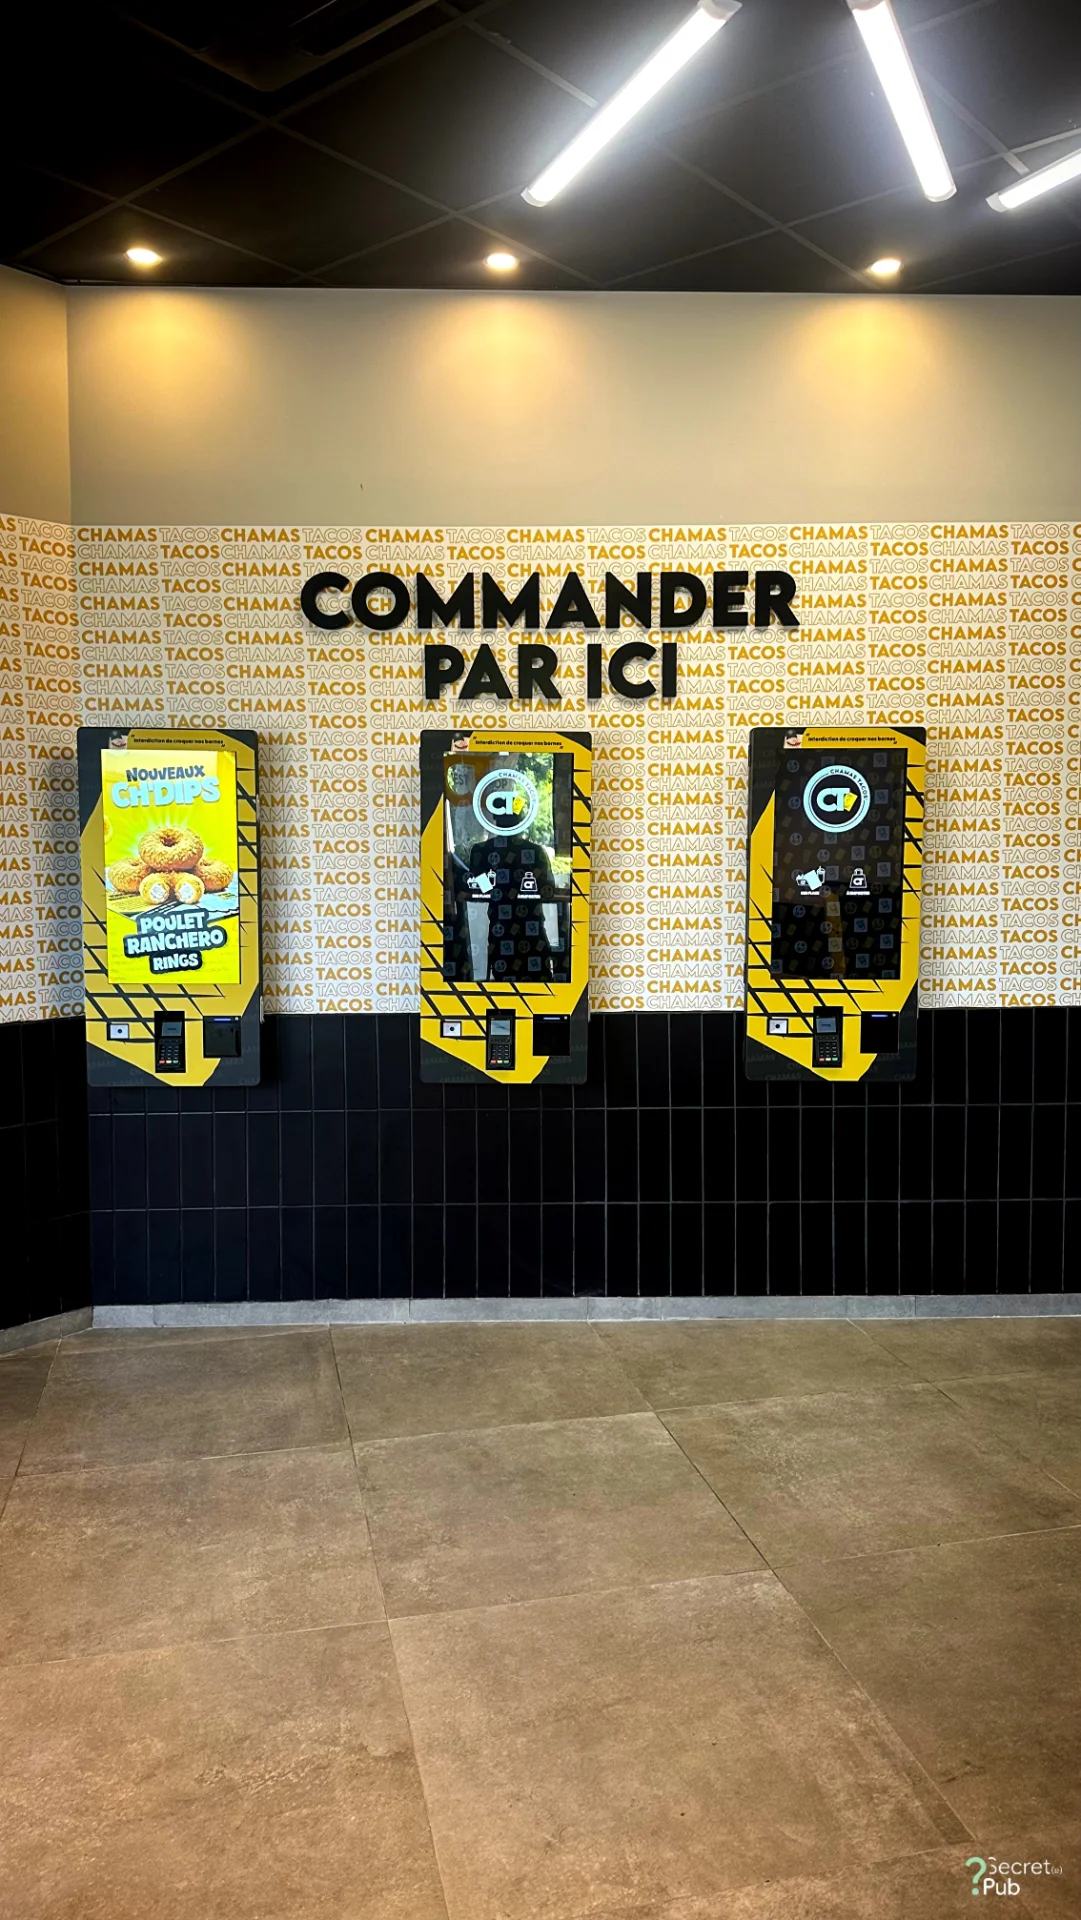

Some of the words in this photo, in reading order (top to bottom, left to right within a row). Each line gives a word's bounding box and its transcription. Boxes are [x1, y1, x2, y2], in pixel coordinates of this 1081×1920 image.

[77, 528, 158, 541] CHAMAS
[220, 528, 301, 542] CHAMAS
[366, 530, 444, 542] CHAMAS
[507, 530, 584, 543] CHAMAS
[649, 528, 726, 541] CHAMAS
[789, 527, 868, 540] CHAMAS
[930, 525, 1009, 538] CHAMAS
[20, 536, 76, 558] TACOS
[161, 544, 219, 559] TACOS
[305, 545, 362, 560] TACOS
[449, 546, 505, 560] TACOS
[588, 544, 645, 559] TACOS
[730, 544, 788, 558] TACOS
[872, 541, 928, 556] TACOS
[1012, 540, 1070, 555] TACOS
[78, 563, 158, 575] CHAMAS
[222, 563, 301, 576] CHAMAS
[789, 561, 867, 574] CHAMAS
[930, 560, 1008, 572] CHAMAS
[22, 572, 78, 592] TACOS
[164, 578, 222, 593] TACOS
[871, 576, 928, 590] TACOS
[1011, 574, 1068, 589] TACOS
[80, 596, 160, 609] CHAMAS
[223, 598, 300, 610] CHAMAS
[929, 593, 1006, 606] CHAMAS
[301, 568, 797, 631] COMMANDER
[23, 607, 79, 627] TACOS
[164, 612, 223, 627] TACOS
[870, 610, 927, 624] TACOS
[1011, 608, 1067, 622] TACOS
[82, 630, 161, 644] CHAMAS
[225, 632, 303, 644] CHAMAS
[368, 633, 446, 645] CHAMAS
[508, 632, 585, 645] CHAMAS
[647, 632, 726, 644] CHAMAS
[788, 629, 865, 641] CHAMAS
[928, 626, 1007, 639] CHAMAS
[24, 642, 80, 660] TACOS
[166, 646, 224, 661] TACOS
[307, 648, 366, 662] TACOS
[729, 645, 786, 659] TACOS
[869, 643, 926, 657] TACOS
[1009, 641, 1066, 655] TACOS
[83, 664, 163, 677] CHAMAS
[226, 666, 305, 678] CHAMAS
[787, 662, 865, 675] CHAMAS
[927, 660, 1005, 672] CHAMAS
[425, 644, 559, 700] PAR
[590, 642, 677, 700] ICI
[26, 677, 81, 694] TACOS
[167, 683, 225, 695] TACOS
[309, 681, 366, 695] TACOS
[729, 679, 784, 693] TACOS
[868, 676, 926, 691] TACOS
[1008, 675, 1065, 688] TACOS
[84, 700, 164, 711] CHAMAS
[227, 699, 305, 712] CHAMAS
[370, 699, 448, 712] CHAMAS
[508, 698, 586, 713] CHAMAS
[648, 698, 724, 710] CHAMAS
[786, 696, 864, 709] CHAMAS
[927, 693, 1005, 706] CHAMAS
[27, 711, 83, 727] TACOS
[171, 715, 227, 727] TACOS
[311, 714, 368, 729] TACOS
[451, 715, 508, 729] TACOS
[589, 713, 645, 729] TACOS
[728, 712, 785, 726] TACOS
[868, 710, 926, 724] TACOS
[1008, 707, 1065, 722] TACOS
[648, 731, 725, 743] CHAMAS
[926, 726, 1004, 740] CHAMAS
[311, 747, 368, 762] TACOS
[590, 746, 645, 761] TACOS
[1006, 740, 1065, 755] TACOS
[126, 765, 205, 782] NOUVEAUX
[648, 763, 724, 776] CHAMAS
[925, 759, 1001, 773] CHAMAS
[311, 779, 367, 793] TACOS
[590, 775, 644, 792] TACOS
[1005, 771, 1061, 786] TACOS
[112, 777, 221, 808] CH'DIPS
[647, 792, 723, 805] CHAMAS
[924, 788, 1001, 802] CHAMAS
[312, 808, 367, 822] TACOS
[590, 806, 644, 821] TACOS
[1004, 801, 1060, 816] TACOS
[648, 823, 723, 835] CHAMAS
[924, 819, 1001, 832] CHAMAS
[314, 838, 369, 853] TACOS
[590, 838, 645, 852] TACOS
[1005, 833, 1061, 847] TACOS
[647, 854, 721, 866] CHAMAS
[923, 850, 999, 863] CHAMAS
[316, 871, 370, 885] TACOS
[590, 869, 644, 884] TACOS
[1004, 865, 1060, 879] TACOS
[647, 886, 722, 898] CHAMAS
[922, 883, 998, 895] CHAMAS
[316, 902, 371, 917] TACOS
[590, 902, 644, 915] TACOS
[1003, 897, 1059, 911] TACOS
[140, 912, 206, 934] POULET
[647, 918, 721, 929] CHAMAS
[921, 914, 997, 928] CHAMAS
[127, 930, 224, 955] RANCHERO
[316, 934, 373, 949] TACOS
[590, 933, 644, 949] TACOS
[1002, 929, 1057, 943] TACOS
[153, 954, 199, 971] RINGS
[647, 949, 721, 961] CHAMAS
[921, 947, 997, 959] CHAMAS
[316, 966, 372, 980] TACOS
[590, 965, 644, 980] TACOS
[1001, 961, 1056, 975] TACOS
[646, 981, 721, 992] CHAMAS
[920, 979, 996, 991] CHAMAS
[317, 998, 372, 1012] TACOS
[589, 996, 644, 1010] TACOS
[1000, 993, 1056, 1007] TACOS
